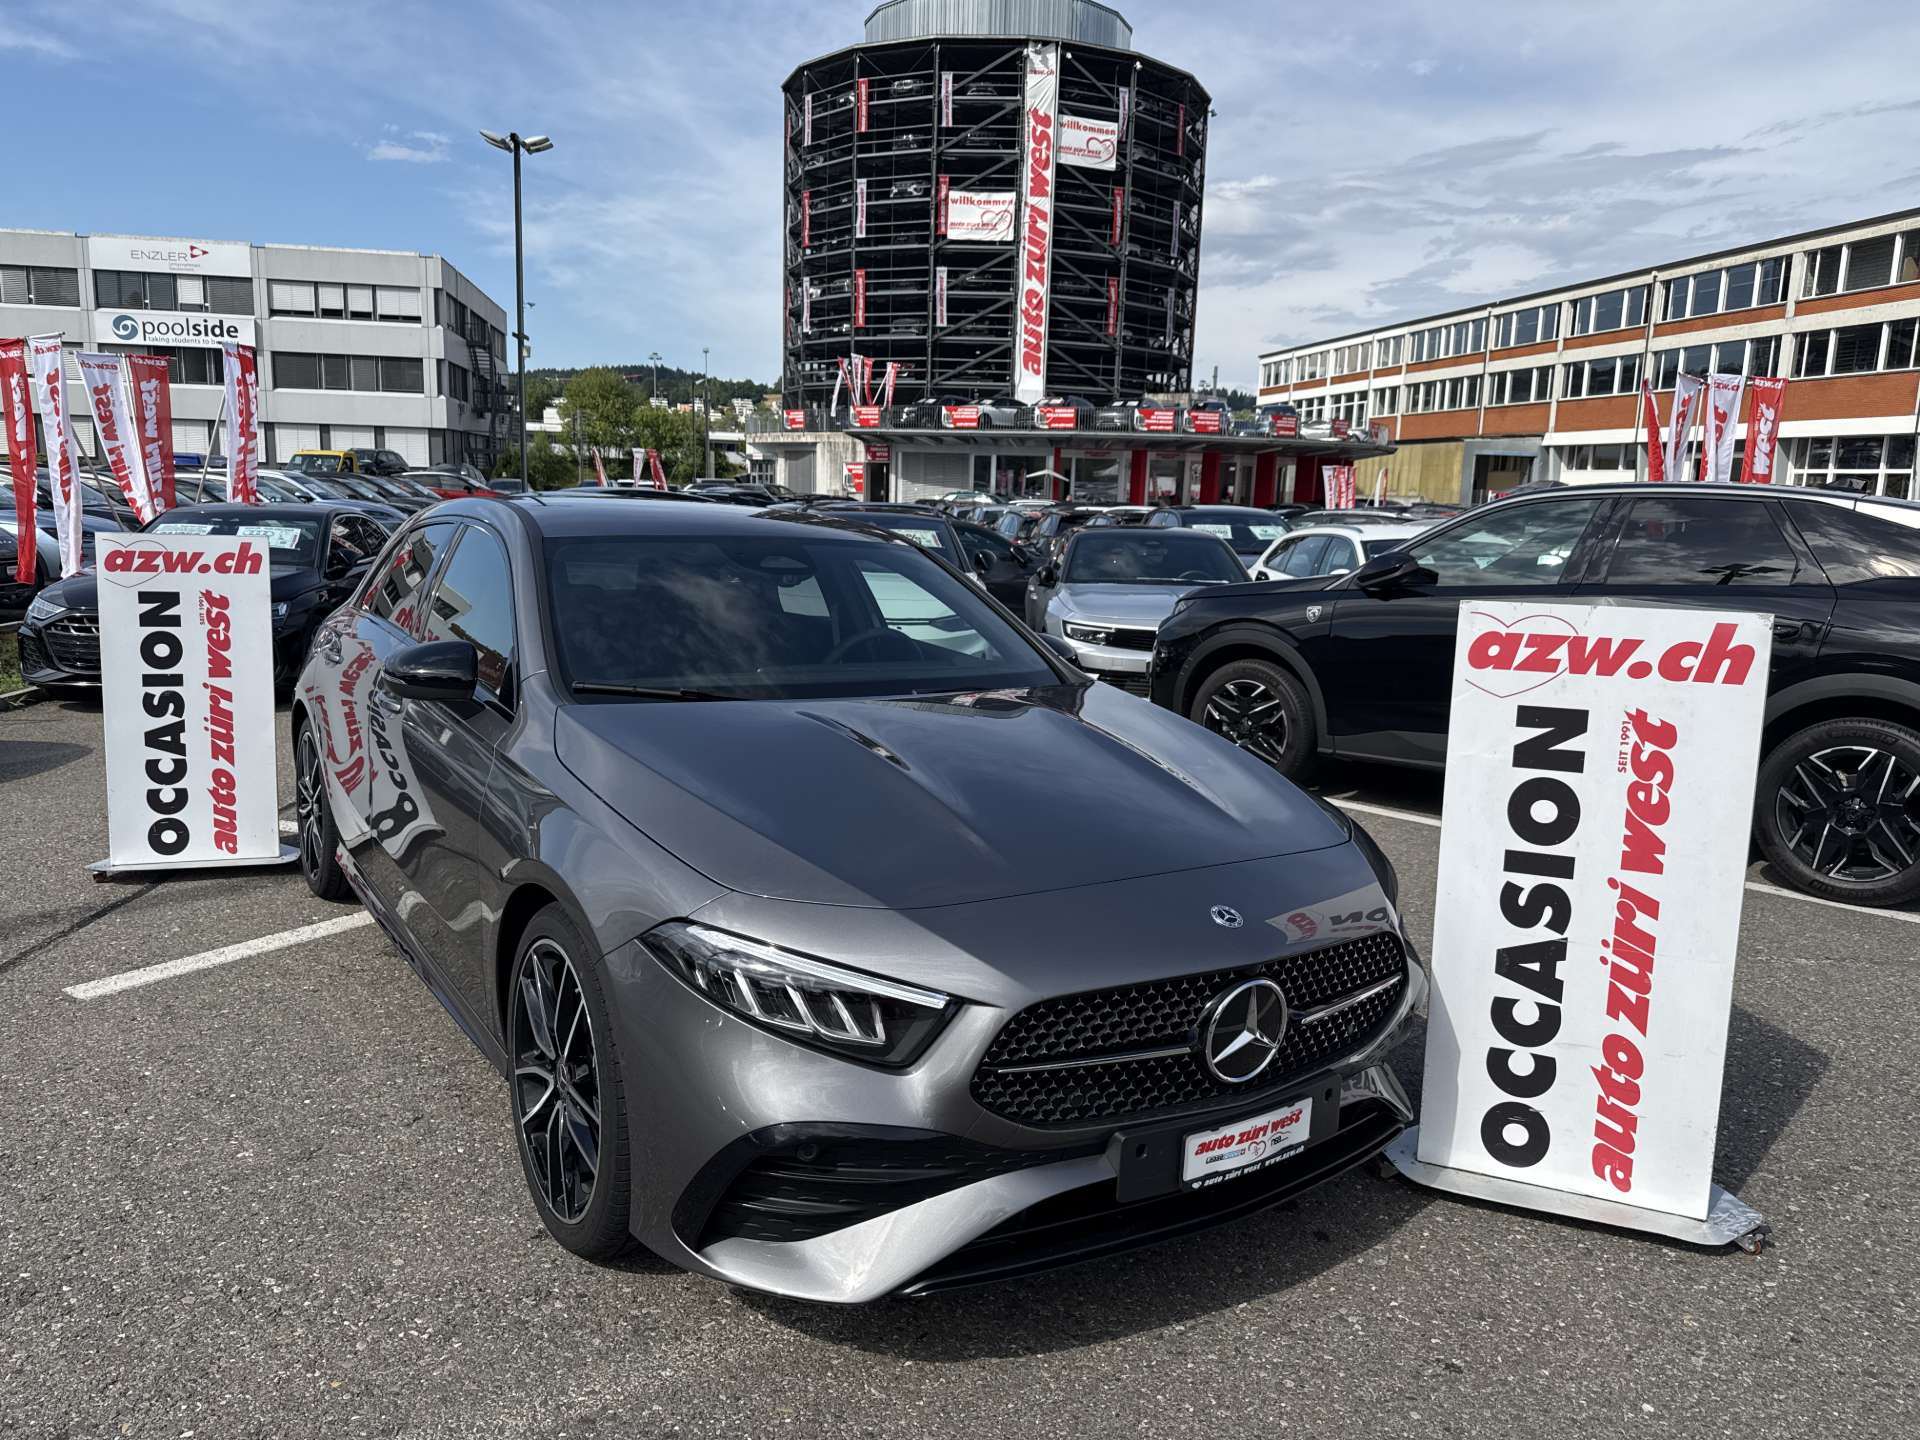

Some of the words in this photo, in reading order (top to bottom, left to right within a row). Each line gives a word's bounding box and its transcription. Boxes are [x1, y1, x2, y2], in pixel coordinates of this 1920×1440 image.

[1027, 106, 1052, 197] west
[1058, 119, 1117, 137] willkommen
[950, 195, 1014, 206] willkommen
[130, 249, 188, 262] ENZLER
[1023, 201, 1050, 288] züri
[142, 317, 239, 342] poolside
[171, 336, 201, 346] students
[202, 337, 210, 346] to
[1022, 288, 1045, 376] auto
[104, 541, 263, 575] azw.ch
[199, 588, 233, 678] west
[1466, 622, 1756, 686] azw.ch
[137, 590, 190, 856] OCCASION
[202, 682, 236, 768] züri
[1617, 750, 1629, 774] SEIT
[1620, 720, 1632, 746] 1991
[206, 768, 239, 855] auto
[1621, 707, 1678, 876] west
[1480, 705, 1590, 1168] OCCASION
[1599, 876, 1662, 1038] züri
[1195, 1132, 1236, 1156] auto
[1236, 1119, 1271, 1146] züri
[1270, 1108, 1304, 1134] west
[1591, 1033, 1645, 1194] auto
